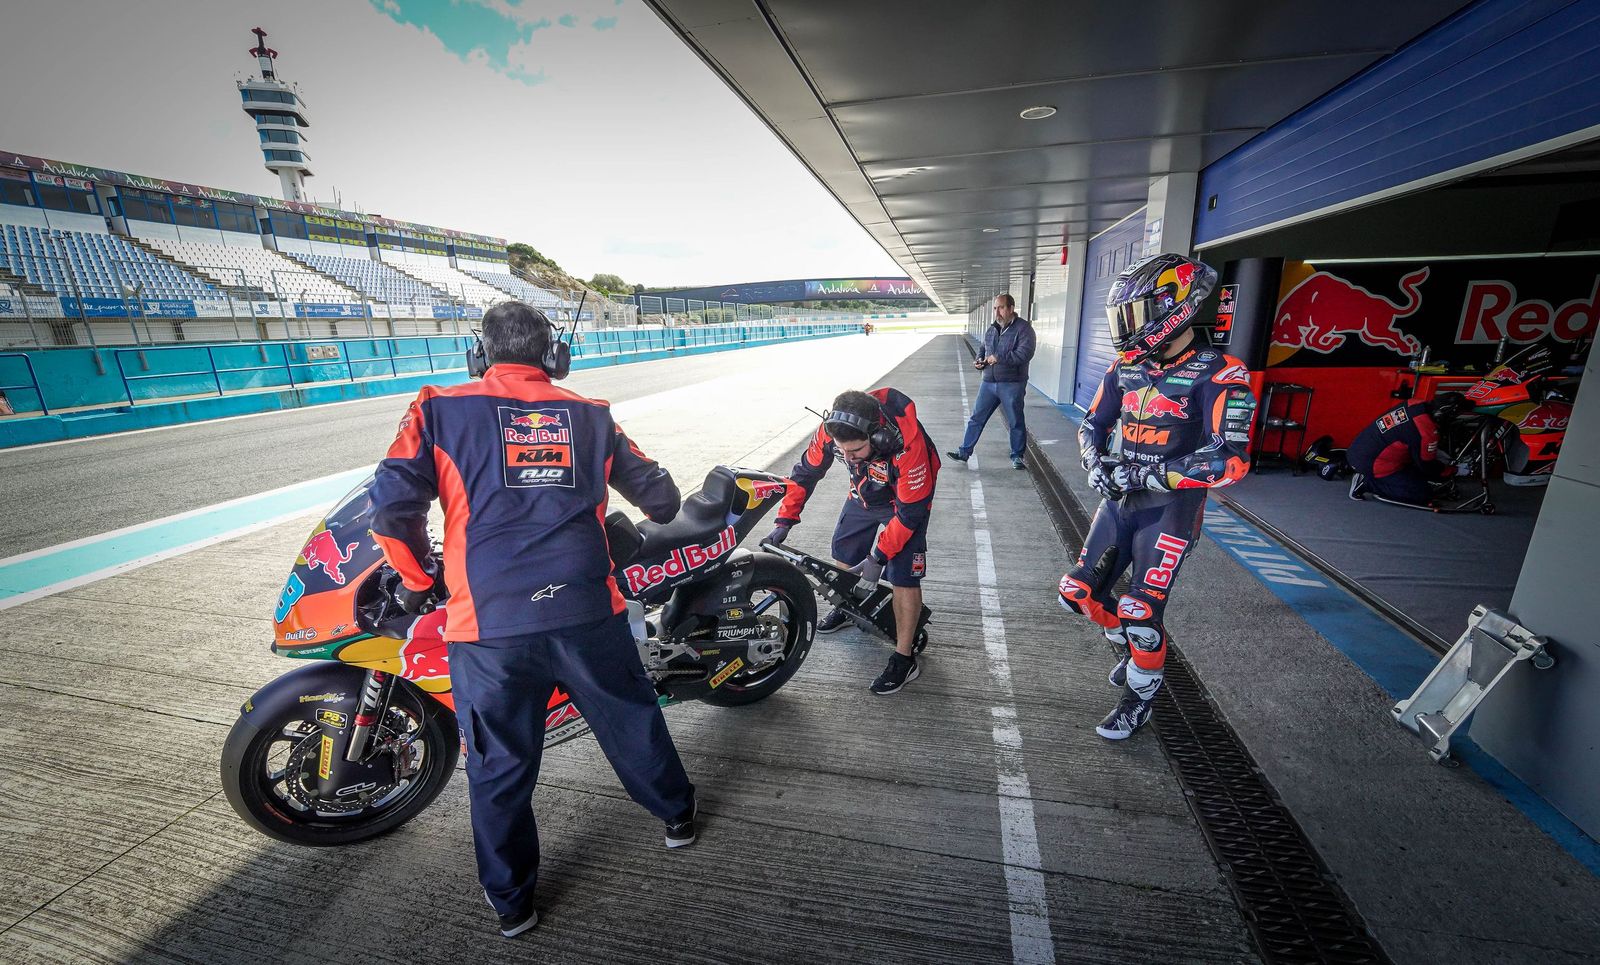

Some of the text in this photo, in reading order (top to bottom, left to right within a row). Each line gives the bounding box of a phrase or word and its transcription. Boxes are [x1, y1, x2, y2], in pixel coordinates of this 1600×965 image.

[817, 283, 861, 295] Andalucía
[1454, 275, 1600, 346] Red
[1144, 301, 1193, 348] Red Bull
[504, 427, 570, 443] Red Bull
[516, 448, 563, 463] KTM
[518, 468, 564, 480] AJO
[622, 524, 737, 598] Red Bull
[1144, 533, 1189, 589] Bull
[722, 595, 737, 604] DID
[717, 627, 755, 640] TRIUMPH
[320, 739, 331, 777] PIRELLI
